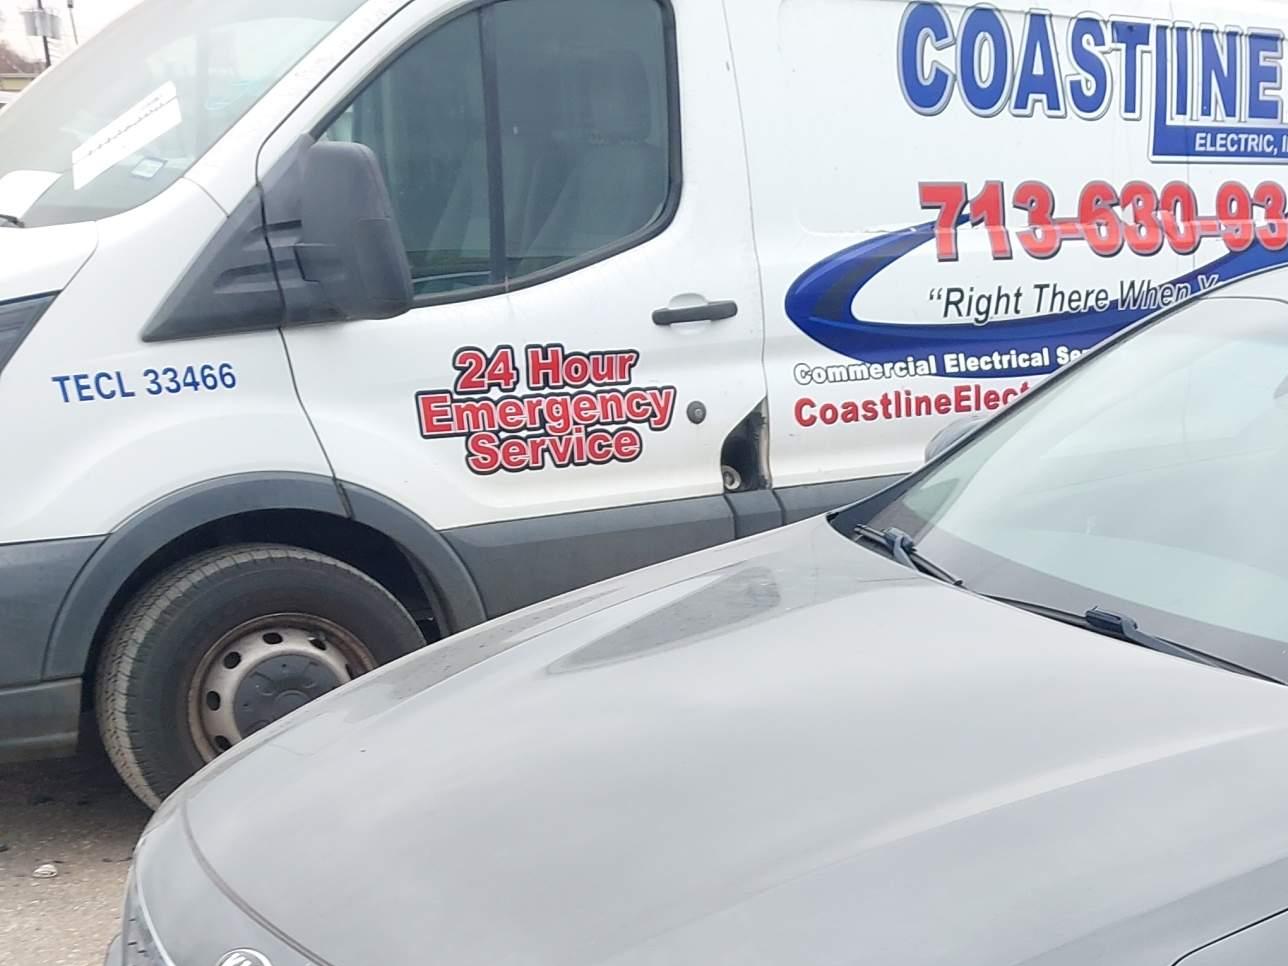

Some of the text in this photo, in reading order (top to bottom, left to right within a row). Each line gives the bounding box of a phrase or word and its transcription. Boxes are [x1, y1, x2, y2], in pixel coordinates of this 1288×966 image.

[898, 2, 1287, 140] COASTLINE
[1194, 132, 1278, 155] ELECTRIC,
[1033, 280, 1110, 314] There
[1118, 279, 1192, 310] When
[52, 363, 237, 402] TECL 33466
[455, 343, 639, 393] 24 Hour
[794, 358, 937, 385] Commercial
[943, 346, 1051, 373] Electrical
[416, 386, 677, 439] Emergency
[466, 426, 642, 475] Service
